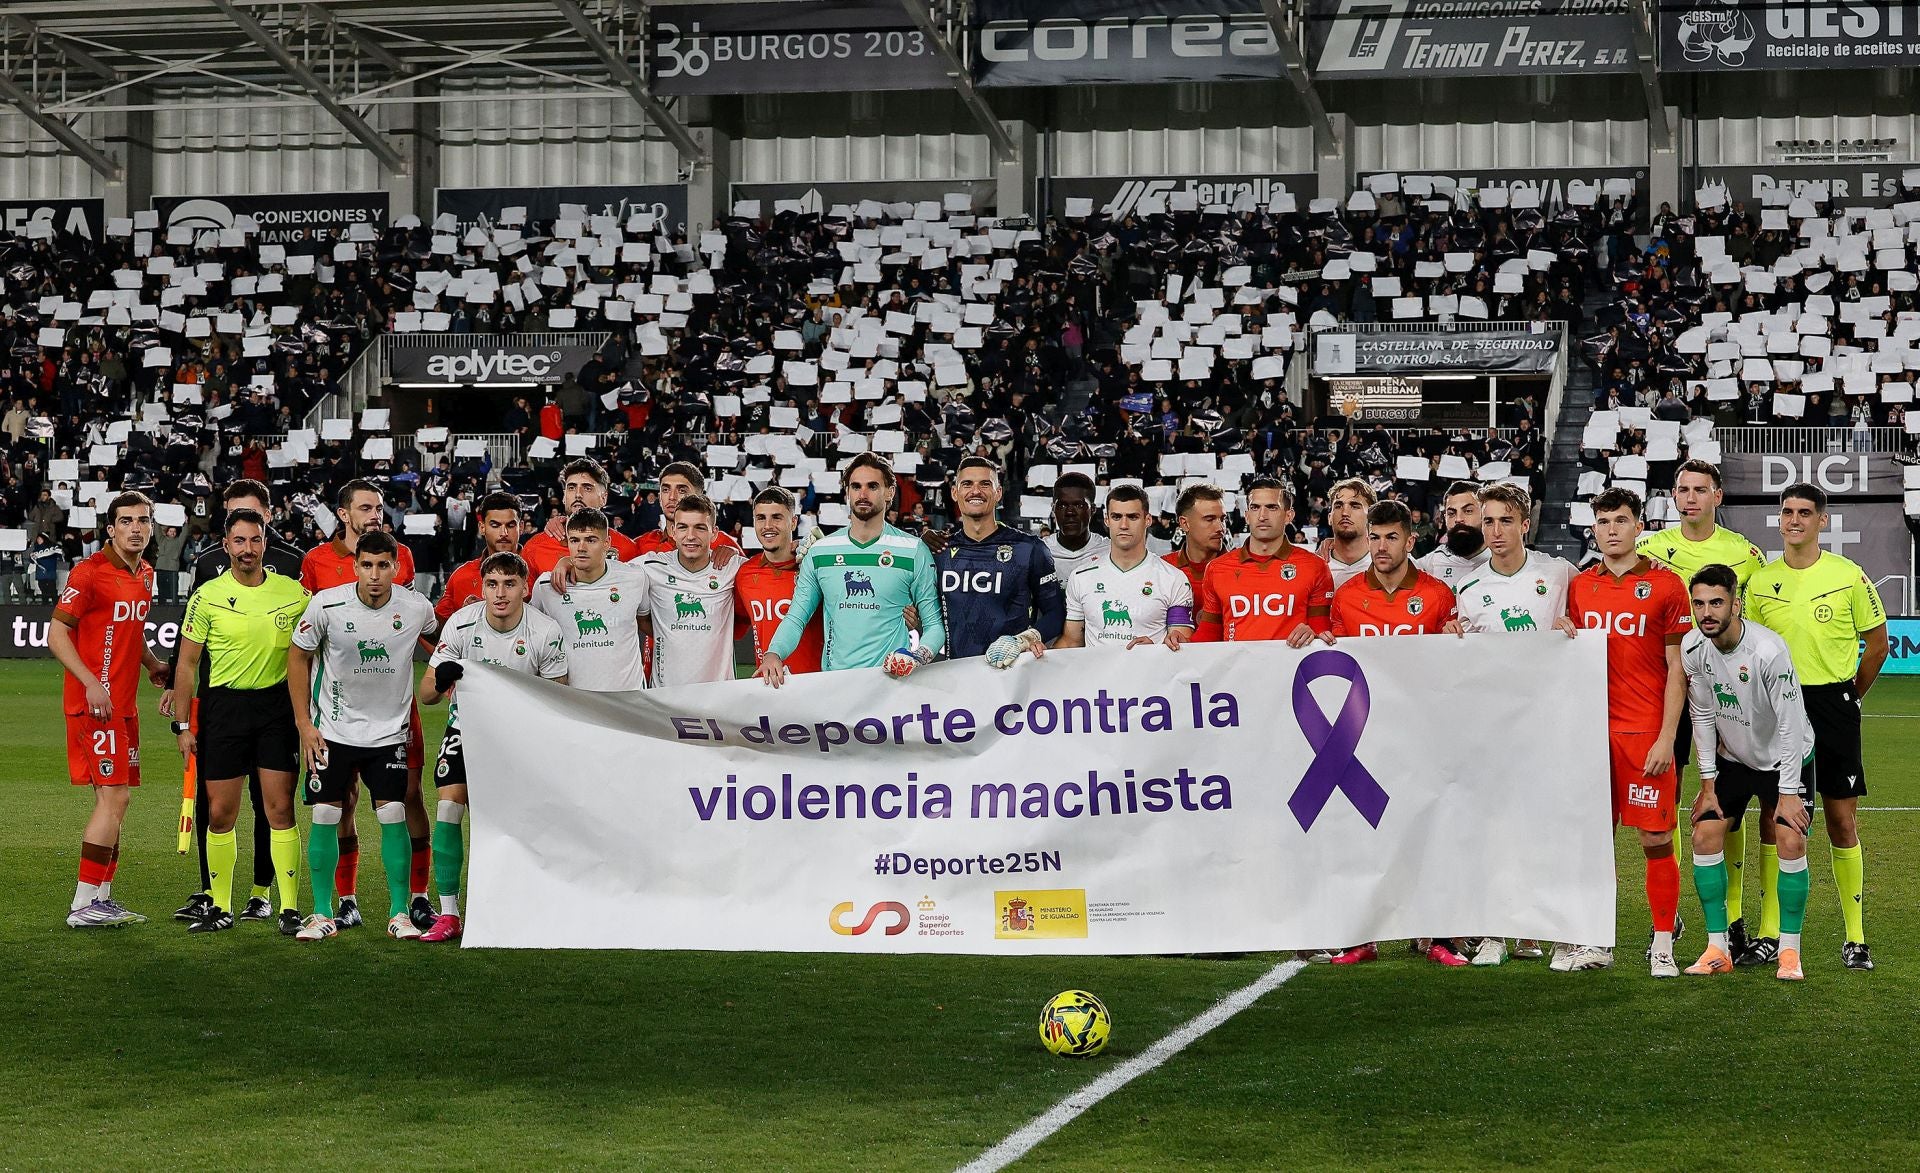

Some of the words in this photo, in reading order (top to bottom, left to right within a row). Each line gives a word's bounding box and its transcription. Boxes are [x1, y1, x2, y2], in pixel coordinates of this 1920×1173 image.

[1766, 0, 1920, 39] GEST
[713, 33, 852, 62] BURGOS
[864, 31, 936, 57] 203
[980, 13, 1280, 62] correa
[1766, 44, 1831, 58] Reciclaje
[1834, 43, 1850, 56] de
[1854, 42, 1903, 55] aceites
[253, 209, 369, 224] CONEXIONES
[370, 208, 384, 223] Y
[1362, 341, 1444, 351] CASTELLANA
[1451, 340, 1469, 350] DE
[1475, 339, 1555, 350] SEGURIDAD
[1363, 355, 1372, 365] Y
[1367, 386, 1420, 394] BUREBANA
[1366, 409, 1407, 419] BURGOS
[1762, 455, 1868, 493] DIGI
[942, 570, 1002, 594] DIGI
[839, 602, 880, 611] plenitude
[1229, 594, 1295, 618] DIGI
[670, 623, 712, 632] plenitude
[1584, 611, 1647, 637] DIGI
[573, 640, 615, 650] plenitude
[101, 649, 112, 682] BURGOS
[354, 667, 396, 675] plenitude
[670, 716, 725, 742] El
[739, 704, 976, 752] deporte
[993, 690, 1174, 736] contra
[1192, 683, 1240, 728] la
[92, 730, 116, 755] 21
[688, 772, 952, 821] violencia
[971, 767, 1233, 819] machista
[874, 850, 1062, 880] #Deporte25N
[919, 914, 950, 922] Consejo
[929, 929, 965, 937] Deportes
